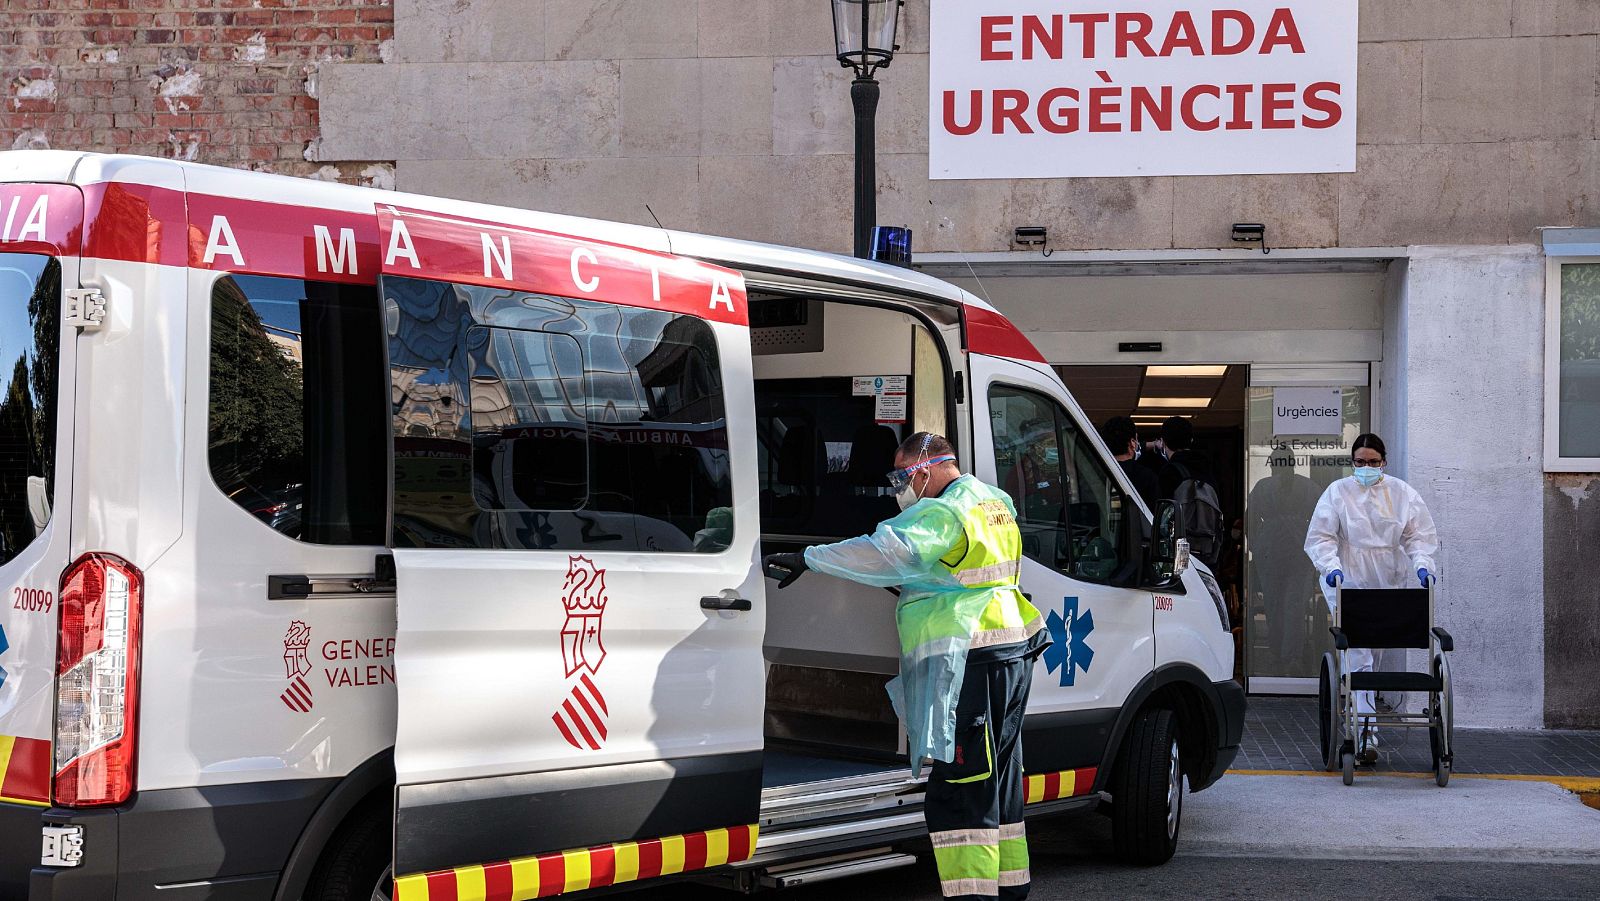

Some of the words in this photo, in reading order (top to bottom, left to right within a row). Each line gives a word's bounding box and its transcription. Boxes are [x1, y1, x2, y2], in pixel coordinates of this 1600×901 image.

[980, 8, 1306, 61] ENTRADA
[942, 71, 1343, 135] URGÈNCIES
[0, 194, 49, 243] IA
[1277, 405, 1339, 419] Urgències
[1270, 435, 1287, 450] Ús
[1292, 438, 1348, 450] Exclusiu
[910, 459, 931, 472] uvex
[14, 587, 53, 614] 20099
[1155, 596, 1173, 611] 20099
[322, 638, 396, 660] GENER
[324, 665, 396, 688] VALEN
